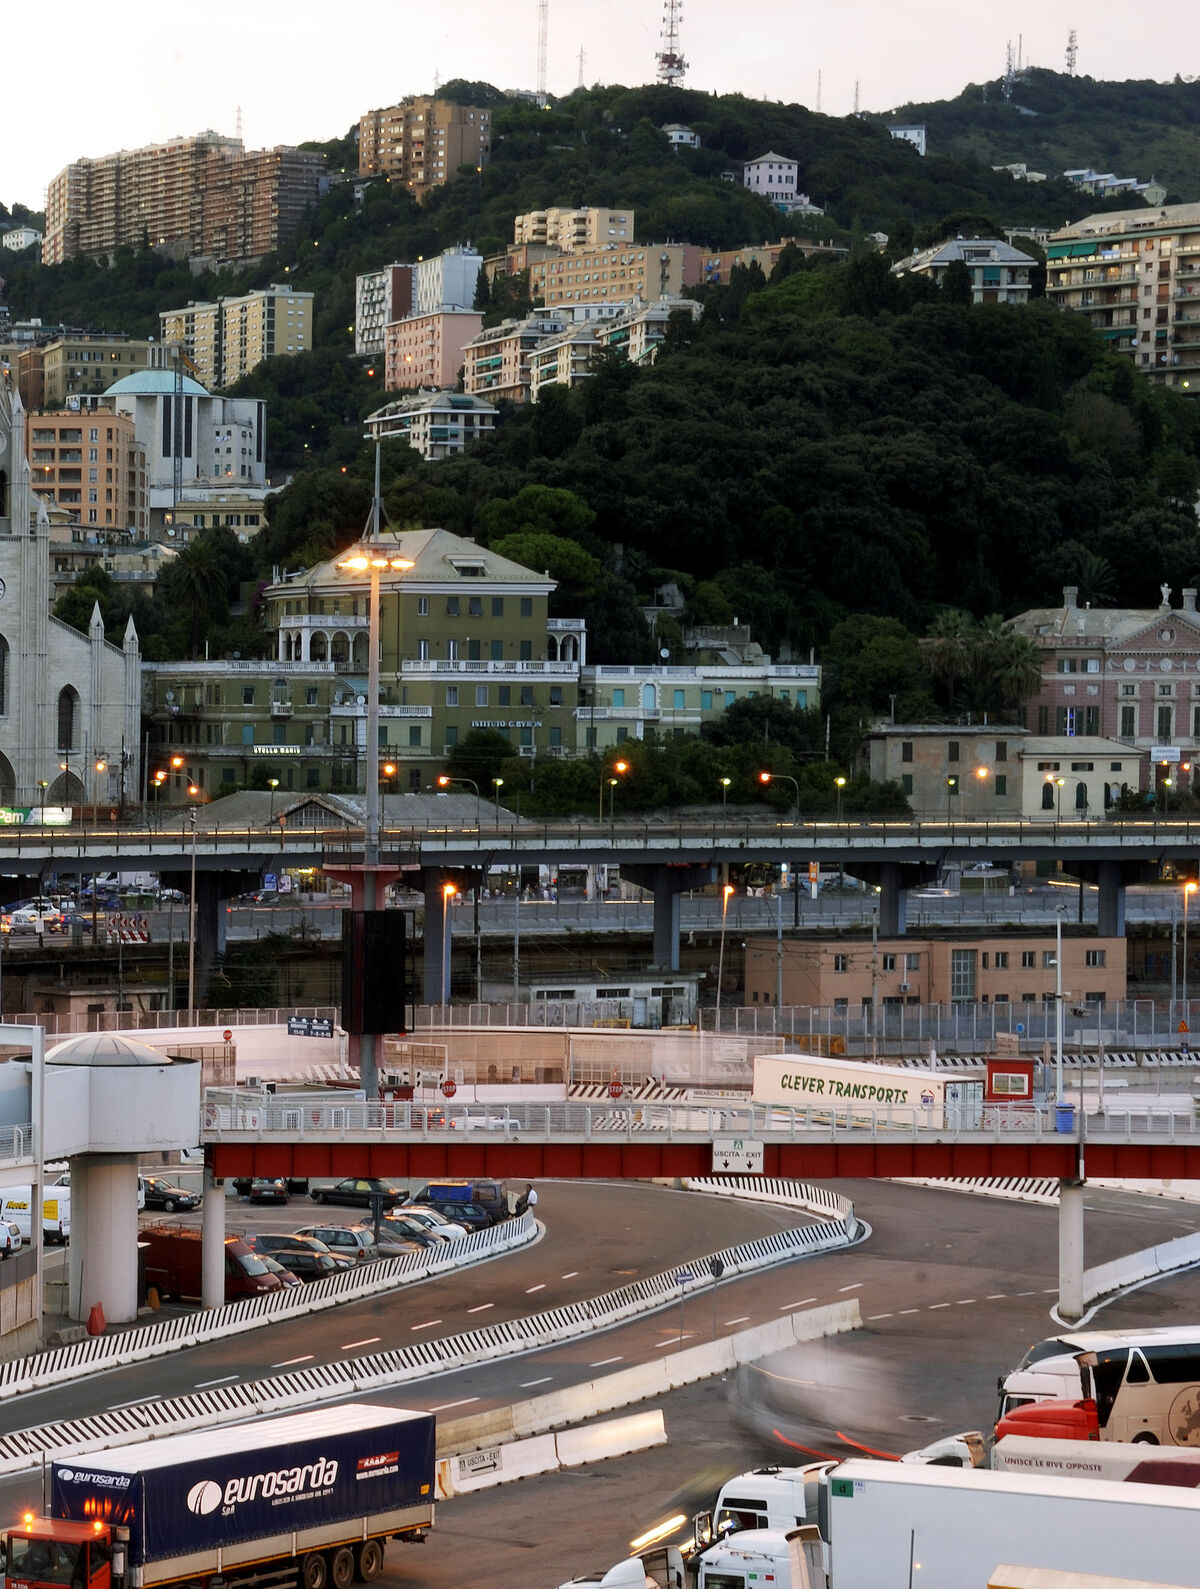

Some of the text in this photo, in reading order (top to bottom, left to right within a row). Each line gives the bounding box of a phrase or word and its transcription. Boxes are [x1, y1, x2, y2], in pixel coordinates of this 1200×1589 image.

[443, 1084, 456, 1093] STOP
[609, 1085, 623, 1093] STOP
[781, 1074, 908, 1104] CLEVER TRANSPORTS
[6, 1201, 29, 1209] Hertz
[467, 1455, 485, 1467] USCITA
[489, 1451, 500, 1461] EXIT
[1004, 1457, 1032, 1467] UNISCE
[1065, 1462, 1102, 1472] OPPOSTE
[74, 1471, 131, 1488] eurosarda
[224, 1457, 339, 1505] eurosarda
[839, 1484, 846, 1493] d
